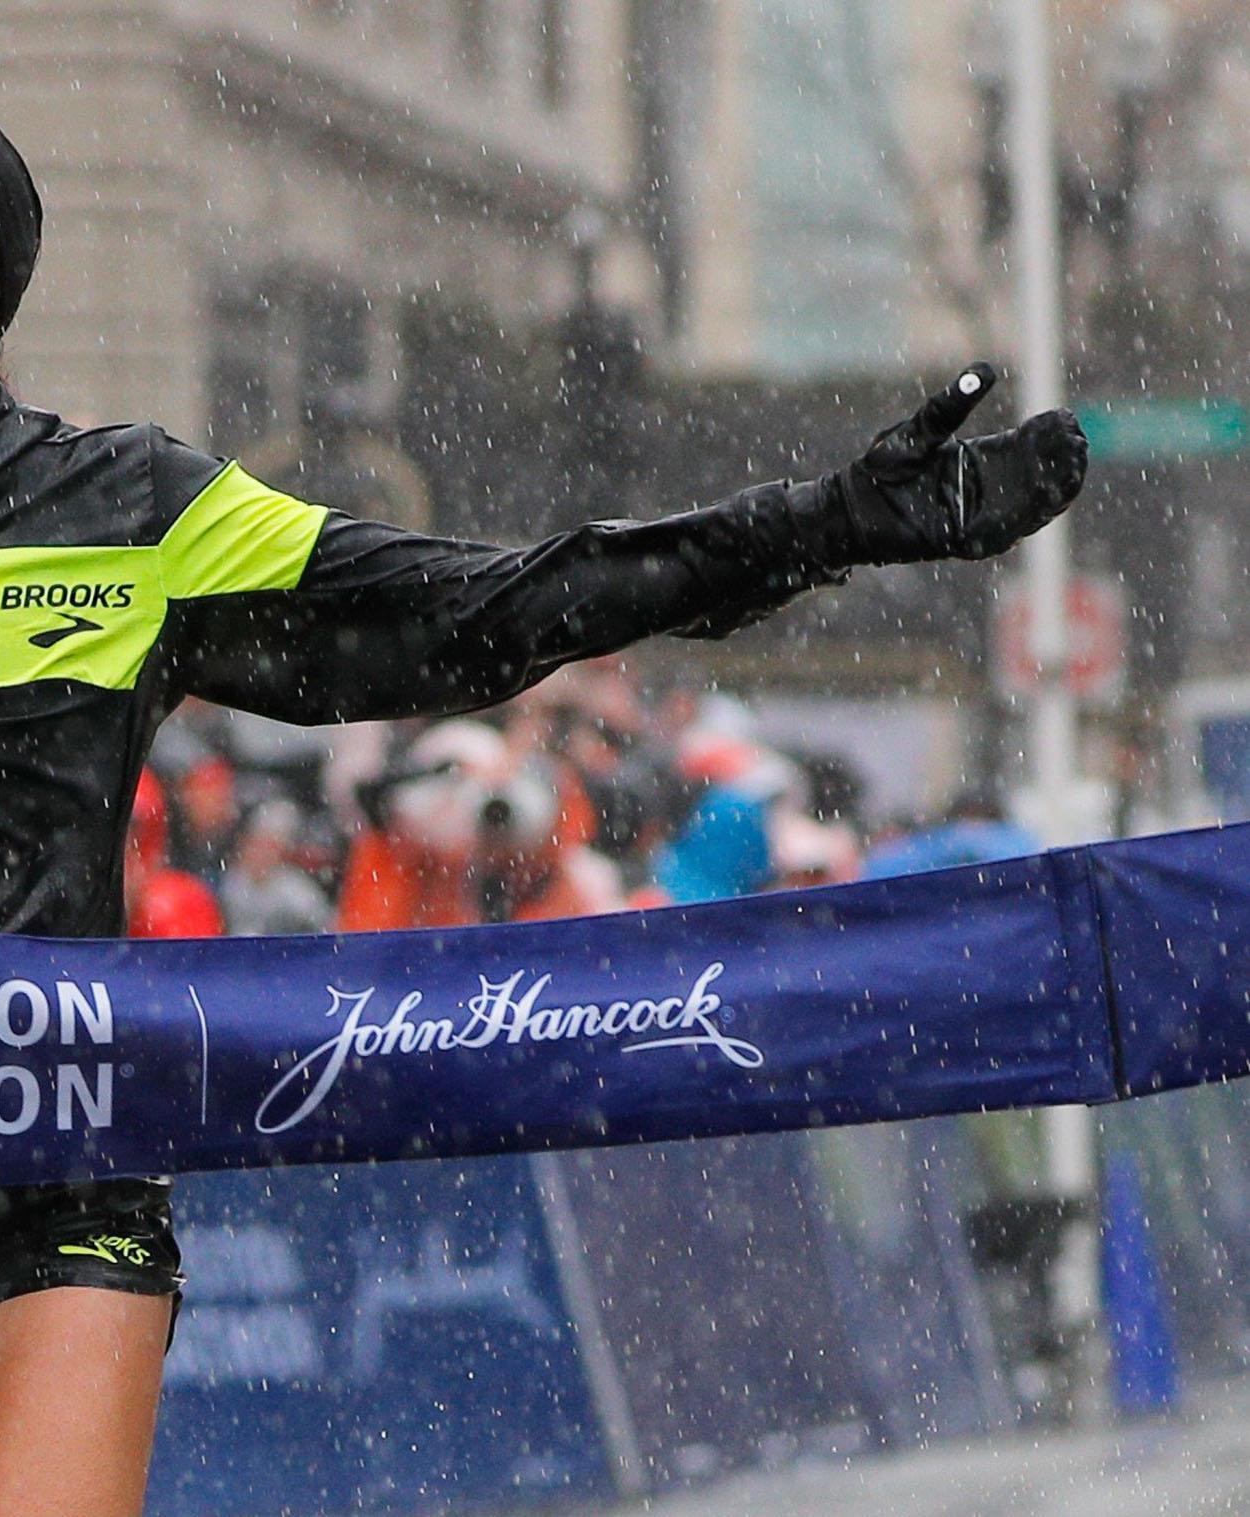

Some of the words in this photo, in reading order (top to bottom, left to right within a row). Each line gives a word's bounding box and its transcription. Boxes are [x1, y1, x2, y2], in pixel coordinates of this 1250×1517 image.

[0, 584, 135, 610] BROOKS
[256, 983, 453, 1134] John
[451, 962, 764, 1068] Hancock
